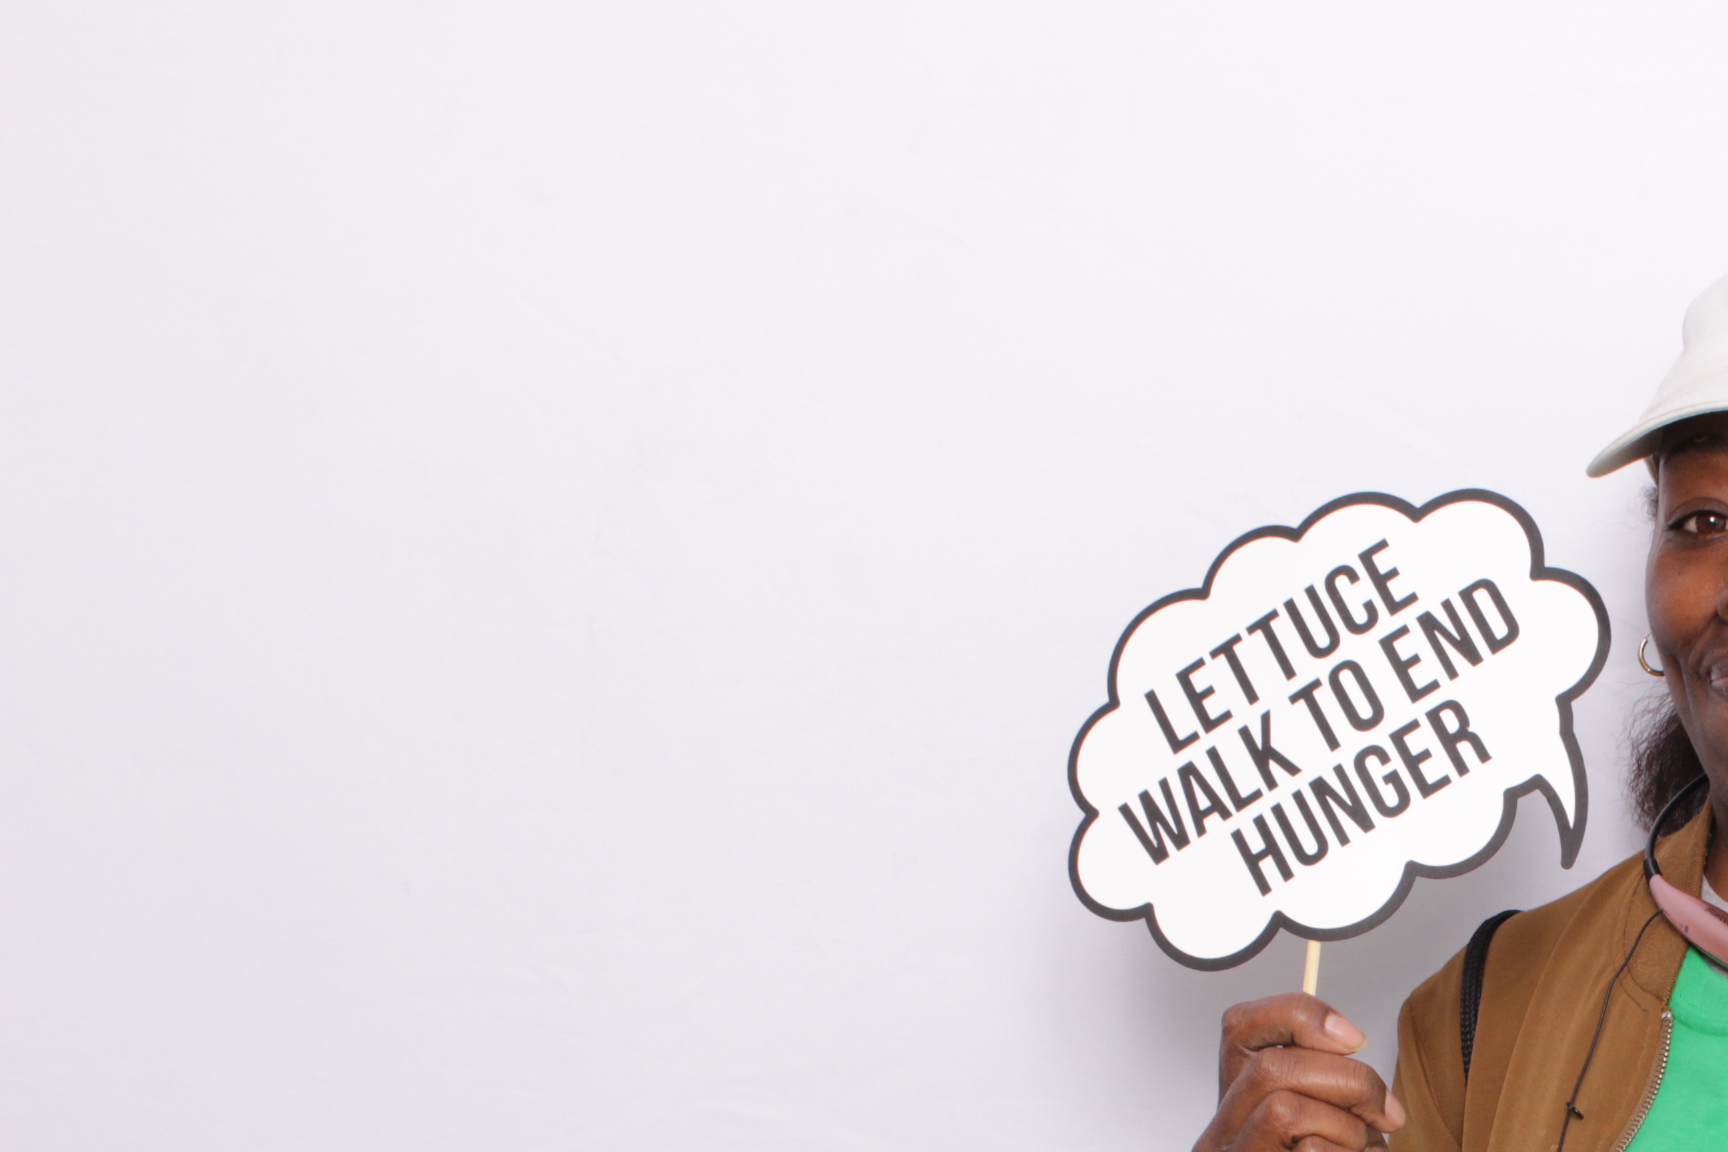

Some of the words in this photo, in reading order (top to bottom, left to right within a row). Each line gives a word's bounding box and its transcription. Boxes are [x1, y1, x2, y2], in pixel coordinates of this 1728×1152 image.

[1117, 709, 1303, 866] WALK
[1288, 659, 1385, 752] TO
[1378, 578, 1520, 704] END
[1143, 538, 1419, 755] LETTUCE
[1230, 699, 1493, 897] HUNGER
